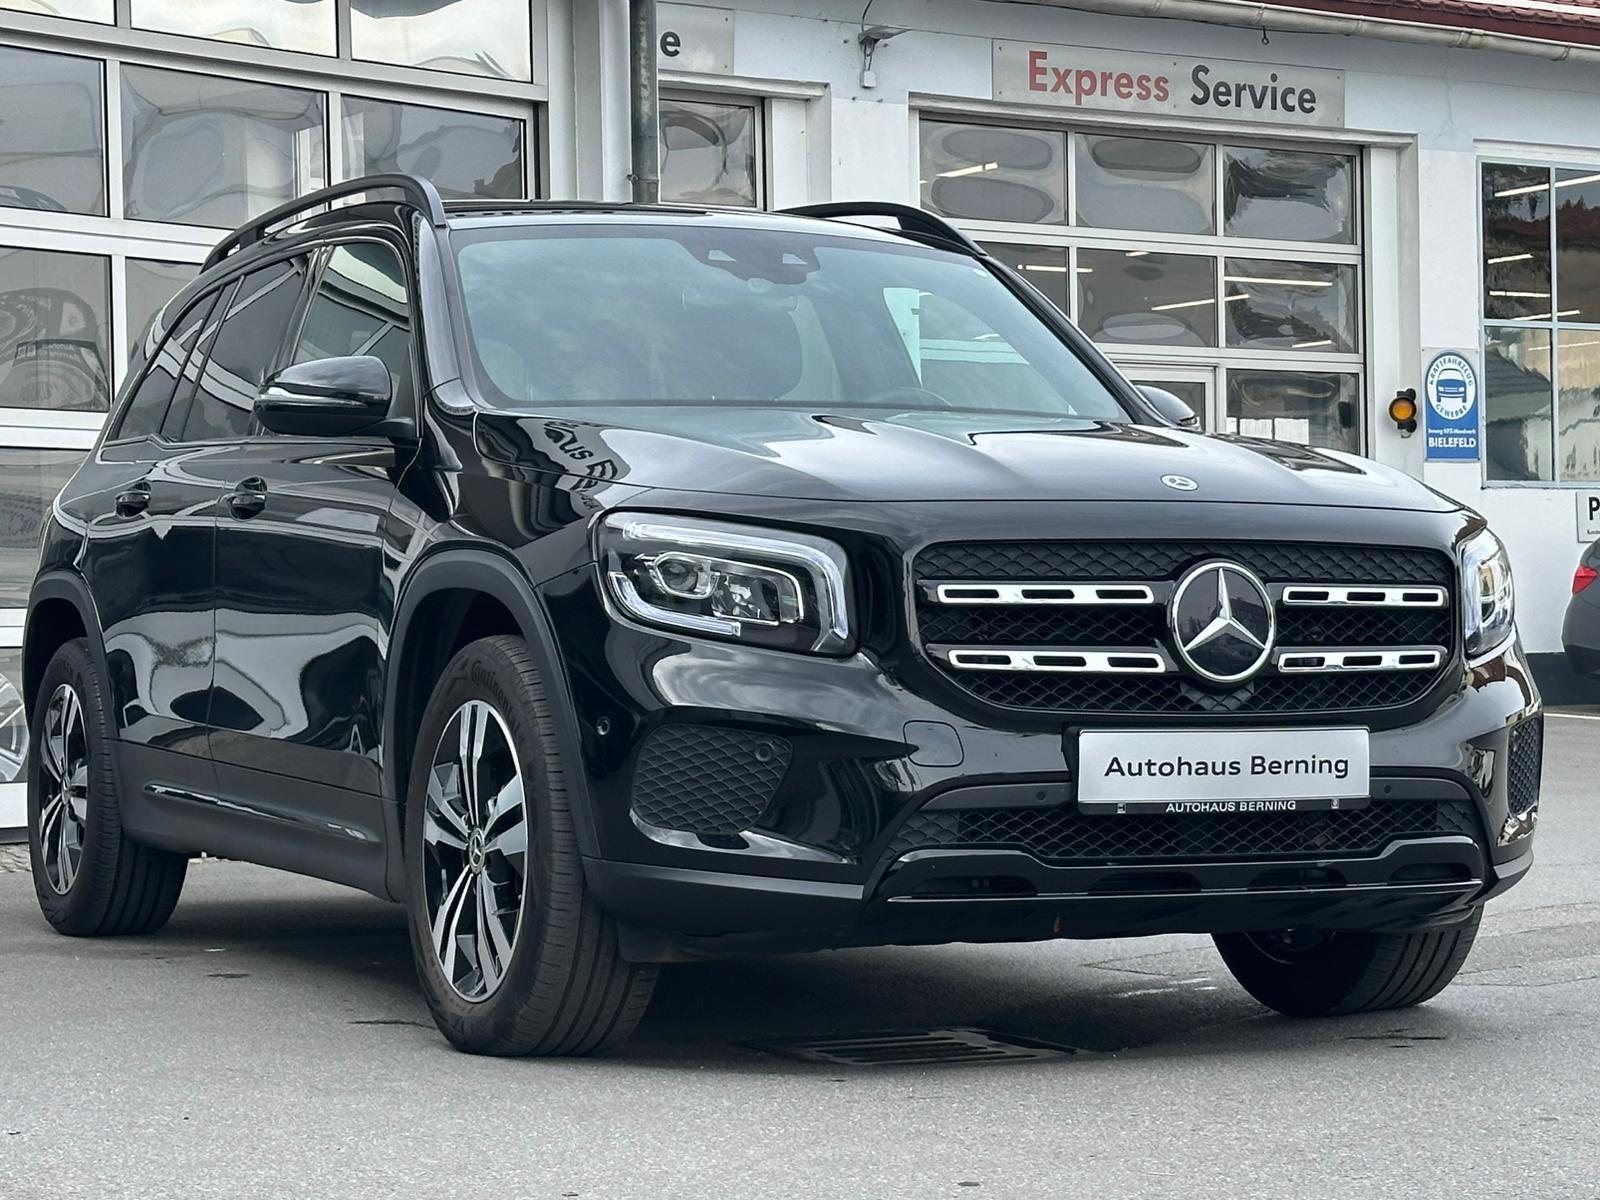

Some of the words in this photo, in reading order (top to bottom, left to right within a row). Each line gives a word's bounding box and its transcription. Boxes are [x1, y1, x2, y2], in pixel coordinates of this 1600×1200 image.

[1028, 50, 1169, 105] Express
[1190, 64, 1316, 114] Service
[1428, 437, 1477, 448] BIELEFELD
[1104, 755, 1241, 778] Autohaus
[1250, 754, 1349, 779] Berning
[1165, 801, 1236, 814] AUTOHAUS
[1239, 800, 1297, 812] BERNING
